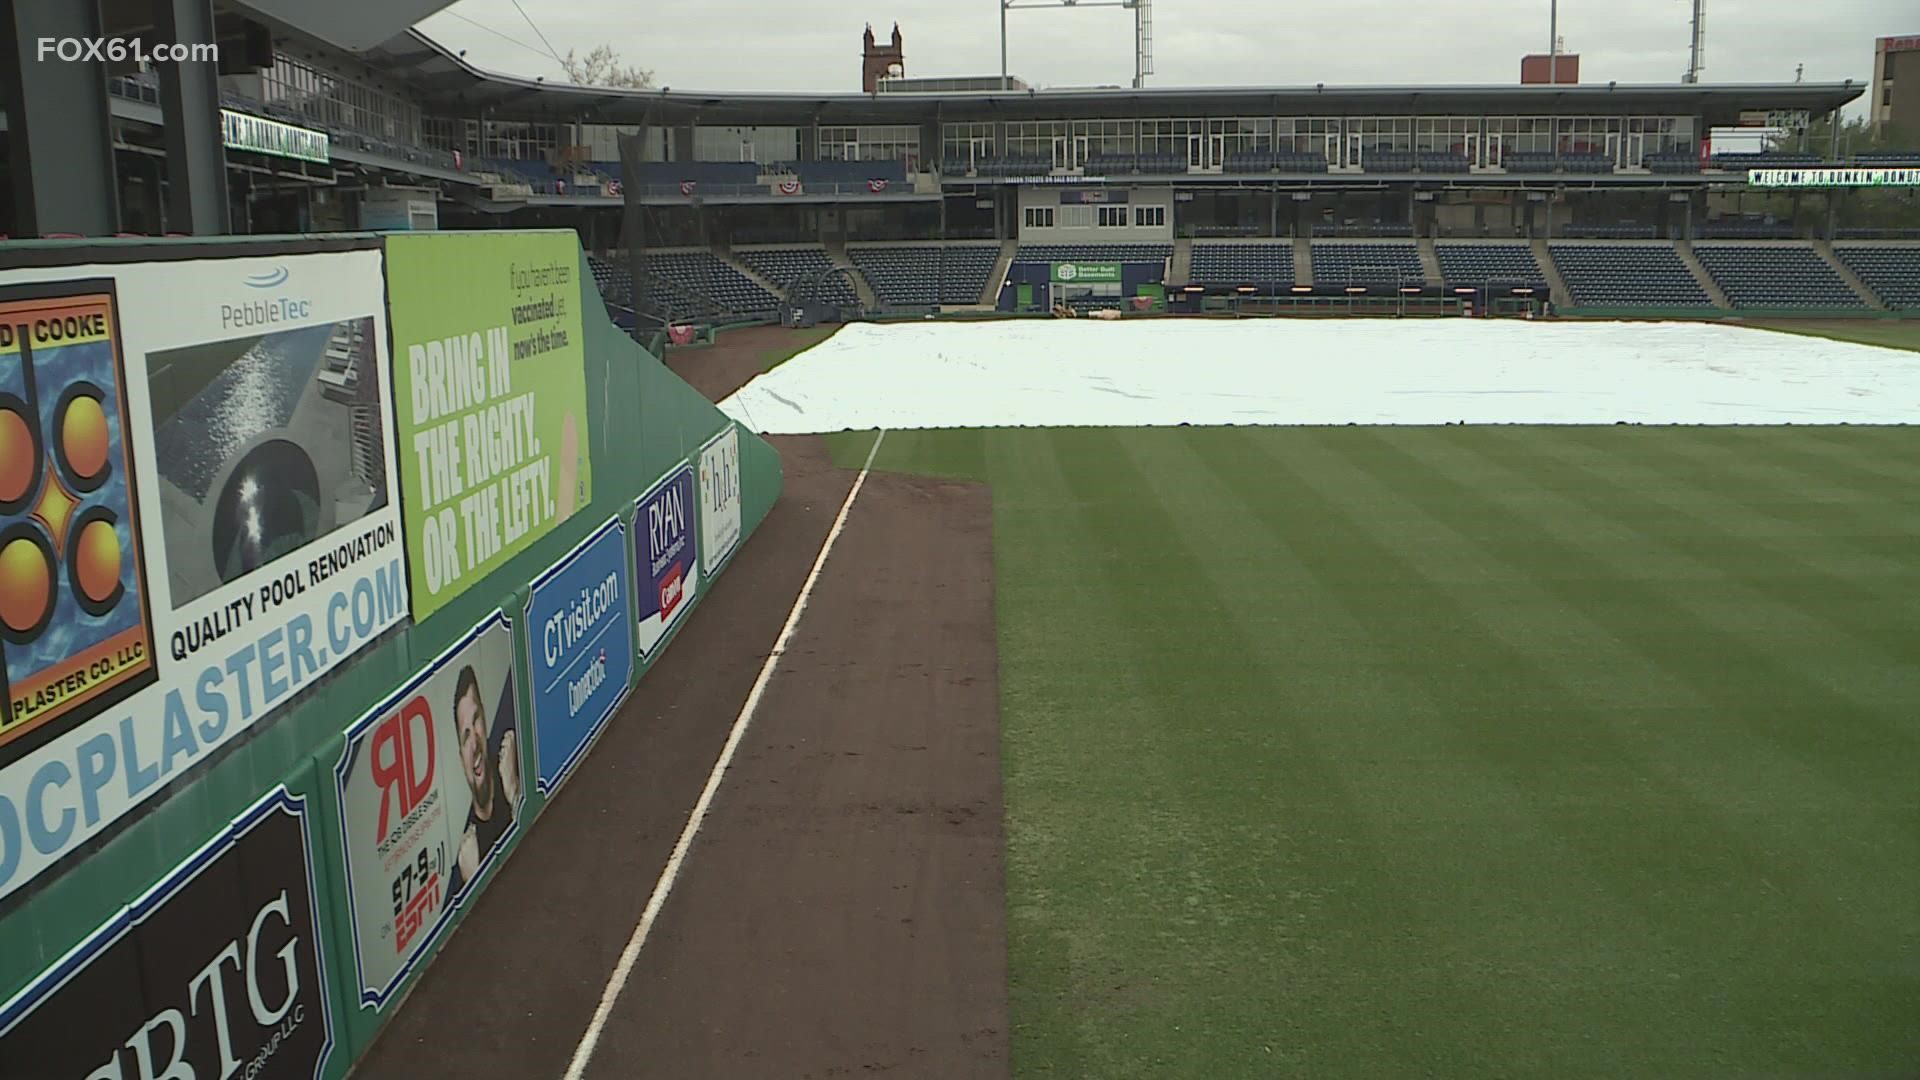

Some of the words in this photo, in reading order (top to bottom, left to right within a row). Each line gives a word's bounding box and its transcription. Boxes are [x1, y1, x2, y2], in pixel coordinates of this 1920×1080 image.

[1754, 171, 1805, 184] WELCOME
[1812, 171, 1824, 184] TO
[1830, 171, 1877, 183] DUNKIN'
[34, 313, 105, 343] COOKE
[221, 298, 308, 329] PebbleTec
[511, 293, 554, 326] vaccinated
[537, 327, 550, 354] the
[408, 331, 486, 426] BRING
[486, 326, 511, 399] IN
[413, 420, 463, 512] THE
[464, 391, 540, 488] RIGHTY.
[422, 507, 461, 596] OR
[460, 482, 502, 571] THE
[502, 455, 555, 546] LEFTY.
[649, 481, 685, 561] RYAN
[171, 592, 254, 661] QUALITY
[260, 569, 306, 613] POOL
[309, 520, 395, 587] RENOVATION
[544, 571, 618, 668] CTvisit.com
[661, 576, 681, 609] Canon
[12, 669, 87, 720] PLASTER
[91, 657, 115, 681] CO.
[118, 641, 144, 666] LLC
[394, 872, 440, 955] ESPN
[245, 1031, 281, 1080] GROUP
[281, 1004, 304, 1039] LLC
